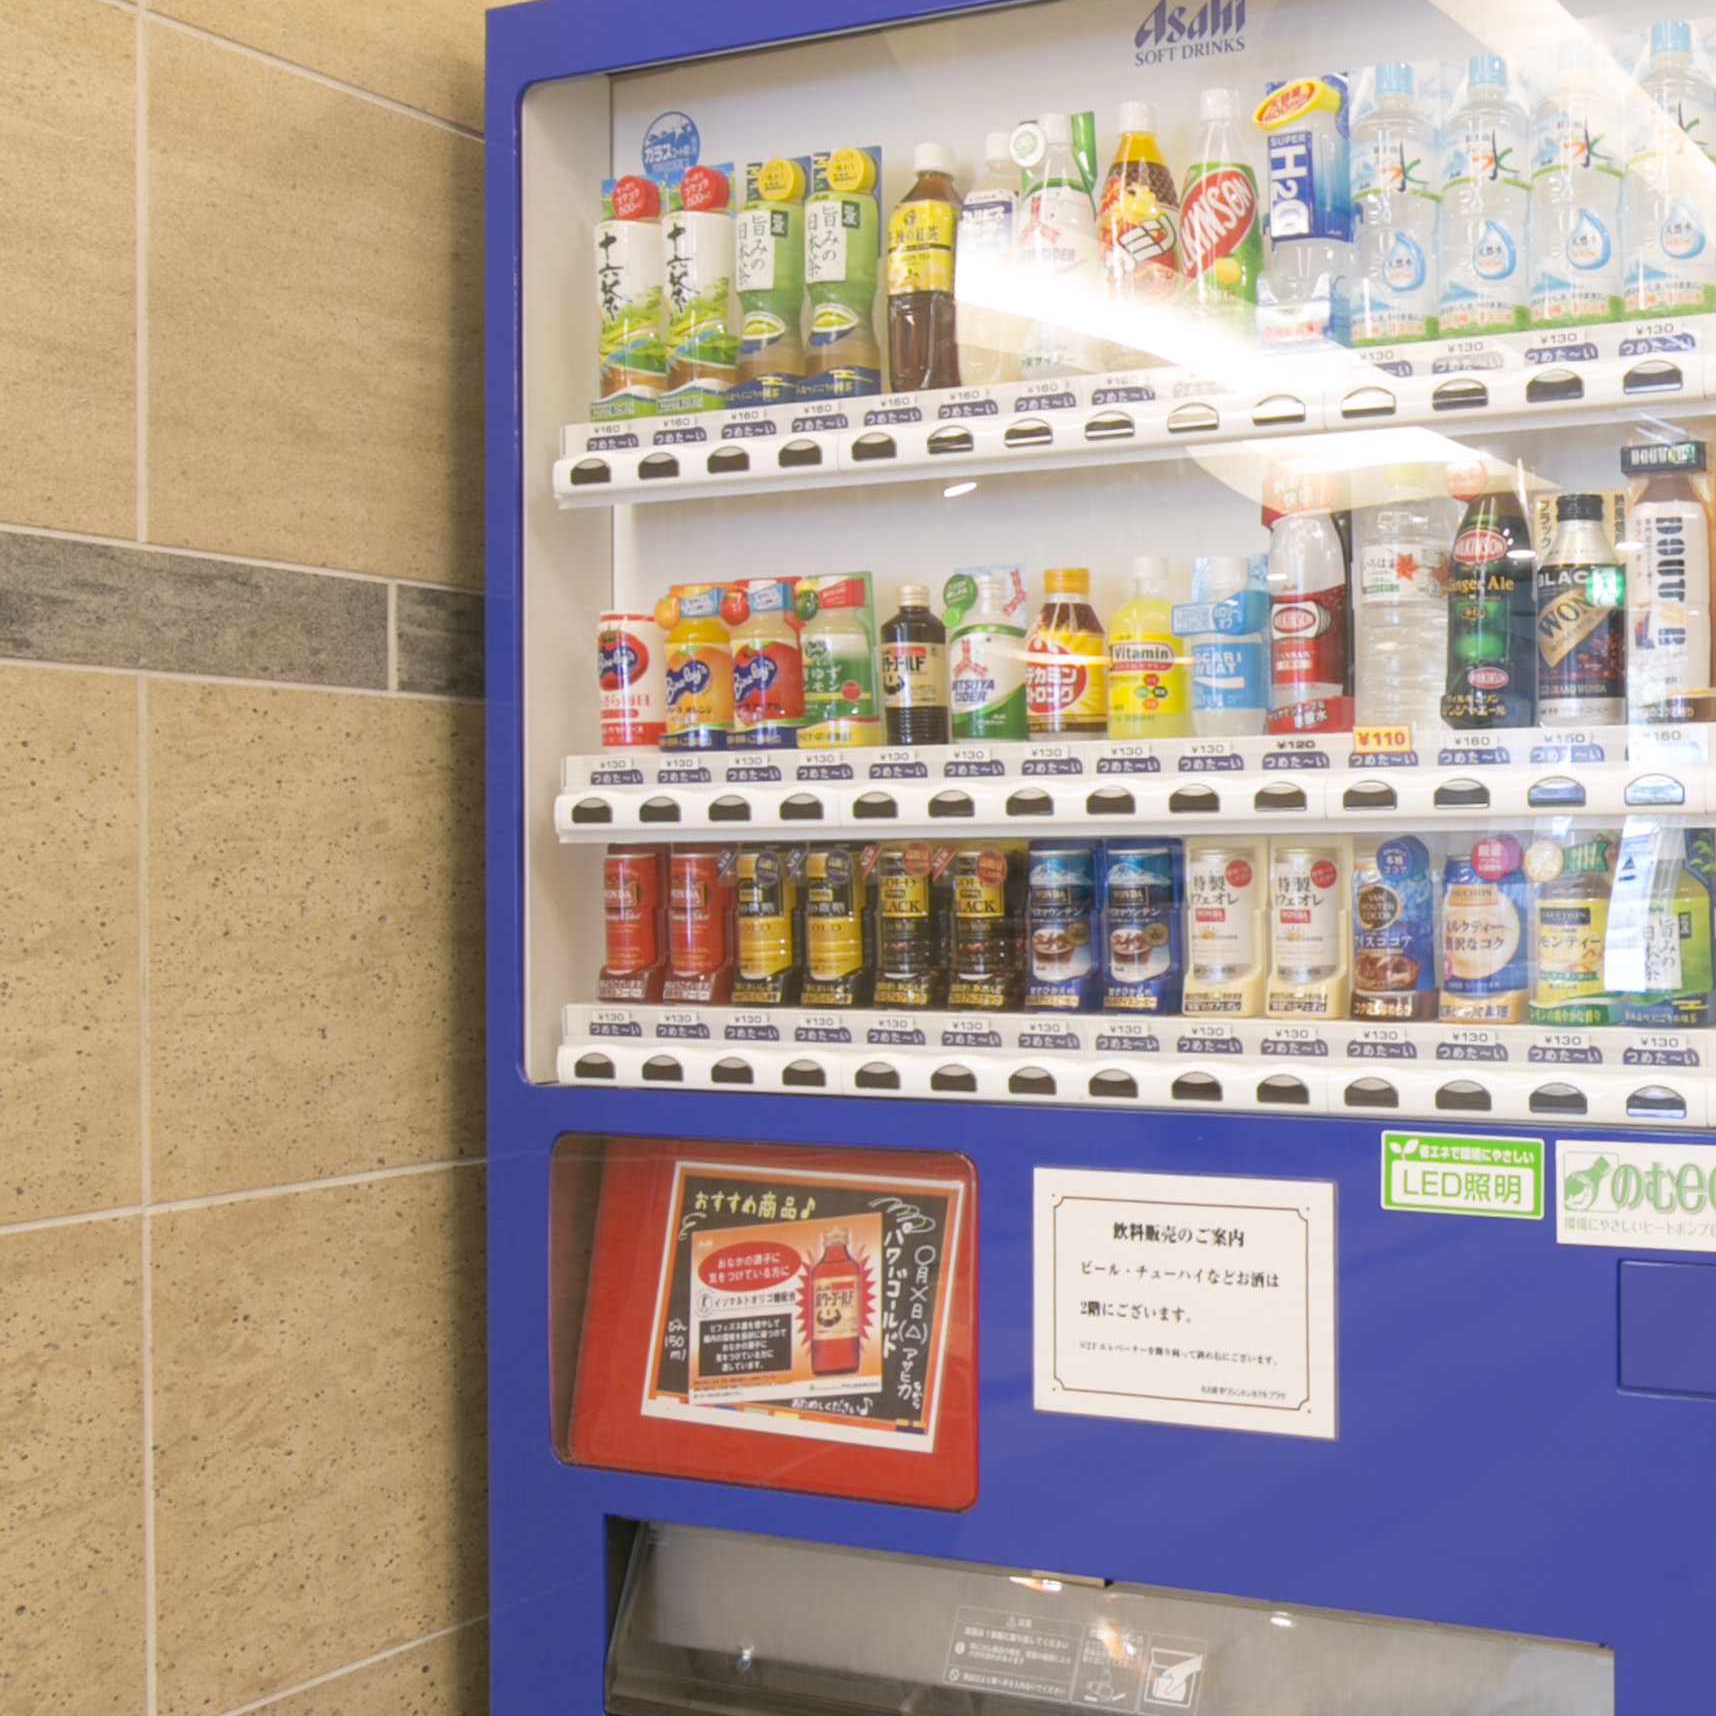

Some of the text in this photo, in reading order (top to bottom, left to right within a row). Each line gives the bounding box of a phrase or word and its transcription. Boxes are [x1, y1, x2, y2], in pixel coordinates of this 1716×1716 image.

[1135, 37, 1245, 67] SOFT DRINKS
[1270, 134, 1306, 146] SUPER
[822, 205, 839, 261] 旨みの
[598, 231, 633, 322] 十六茶
[666, 223, 701, 320] 十六茶
[1636, 323, 1674, 336] ¥130
[1113, 646, 1169, 661] Vitamin
[953, 691, 987, 703] CIDER
[1358, 731, 1405, 746] ¥110
[1031, 747, 1062, 758] ¥130
[1368, 893, 1385, 902] VAN
[1361, 903, 1395, 912] HOUTEN
[1362, 912, 1391, 920] COCOA
[1110, 1024, 1142, 1035] ¥130
[1452, 1033, 1488, 1042] ¥130
[1419, 1145, 1534, 1164] 省エネで環境にやさしい
[1403, 1169, 1522, 1204] LED照明
[695, 1191, 797, 1220] おすすめ商品
[1113, 1222, 1244, 1247] 飲料販売のご案内
[718, 1253, 780, 1269] おなかの調子に
[709, 1266, 789, 1284] 気をつけている方に
[1081, 1260, 1279, 1288] ビール・チューハイなどお酒は
[1081, 1301, 1191, 1324] 2階にございます。
[664, 1334, 684, 1348] 150
